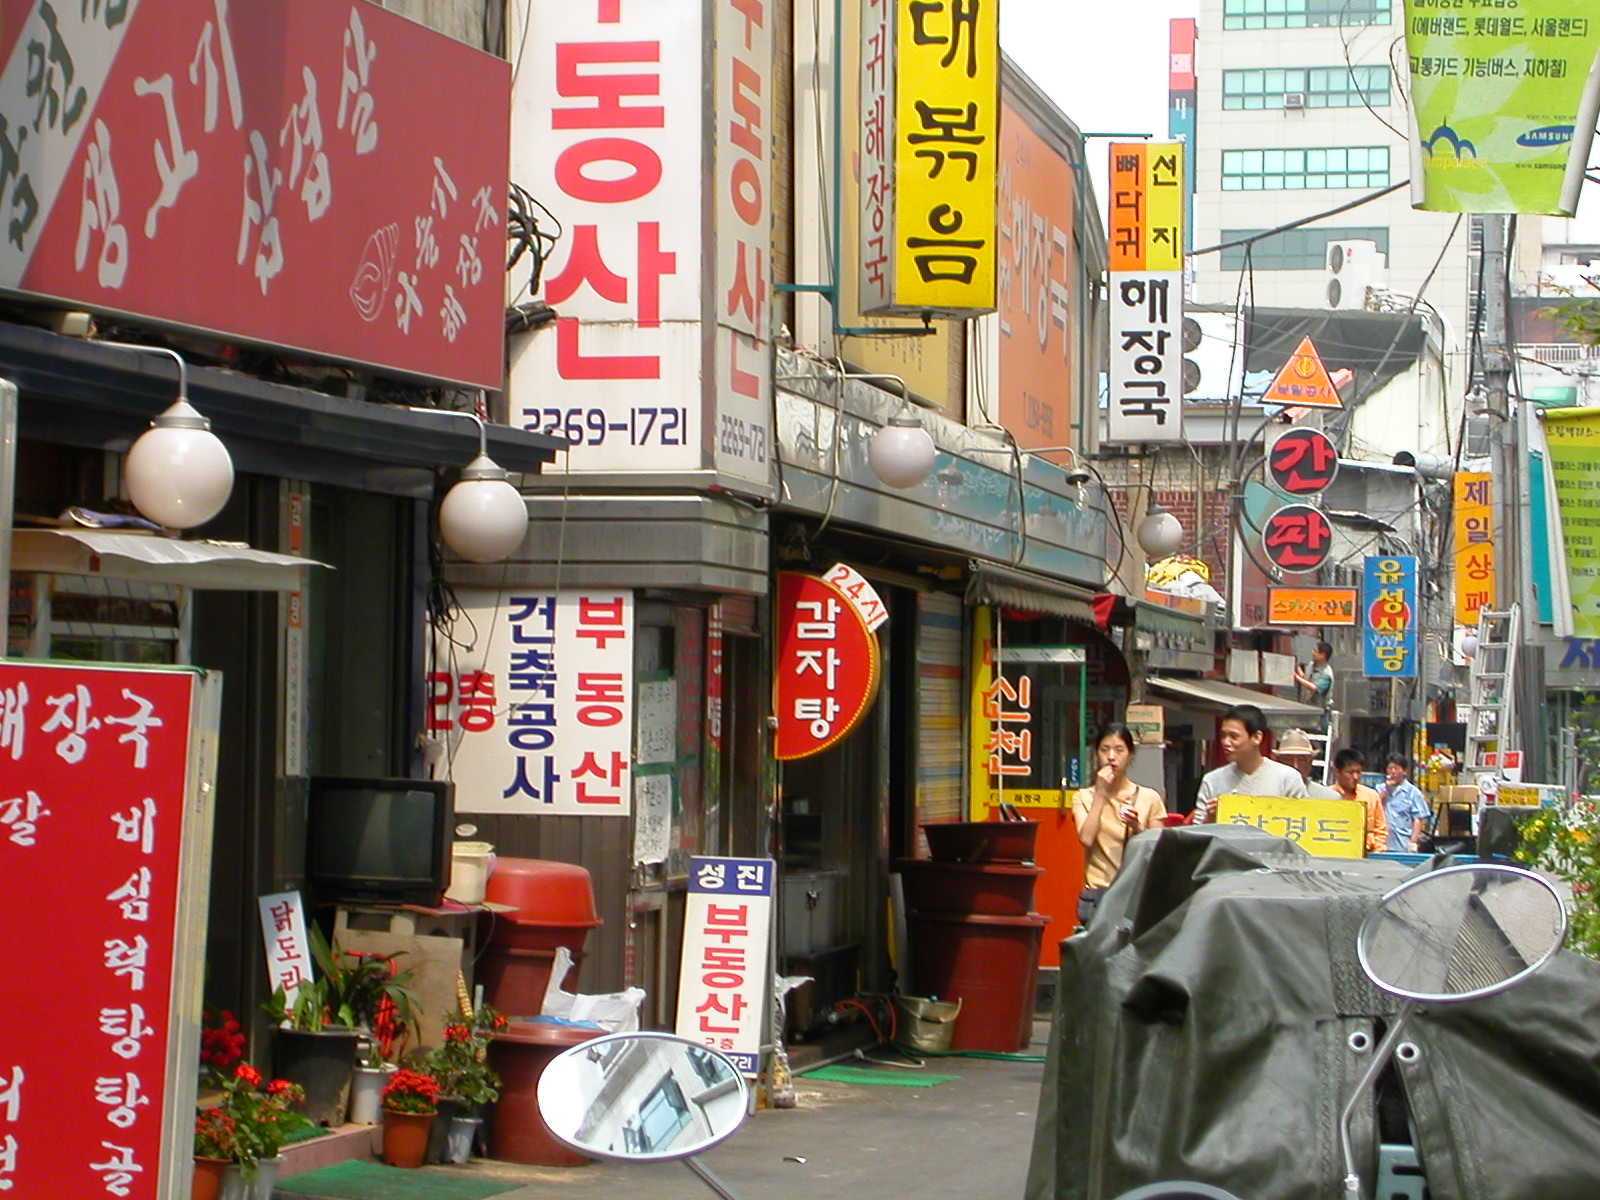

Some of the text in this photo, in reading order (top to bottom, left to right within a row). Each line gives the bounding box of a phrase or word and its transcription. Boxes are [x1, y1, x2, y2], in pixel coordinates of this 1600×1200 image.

[237, 5, 379, 296] 삼겹살
[907, 0, 985, 285] 대볶음
[1116, 154, 1142, 259] 뼈다귀
[1152, 154, 1178, 259] 선지
[440, 185, 499, 343] 해장국
[1119, 279, 1170, 426] 해장국
[522, 408, 687, 446] 2269-1721
[831, 566, 885, 625] 24시
[1464, 480, 1492, 611] 제일상패
[794, 598, 842, 740] 감자탕
[1374, 560, 1408, 671] 유성식당
[503, 597, 561, 805] 건축공사
[571, 597, 629, 805] 부동산
[989, 675, 1031, 776] 신천
[697, 863, 764, 891] 성진
[269, 901, 302, 1021] 닭도리
[696, 904, 749, 1034] 부동산
